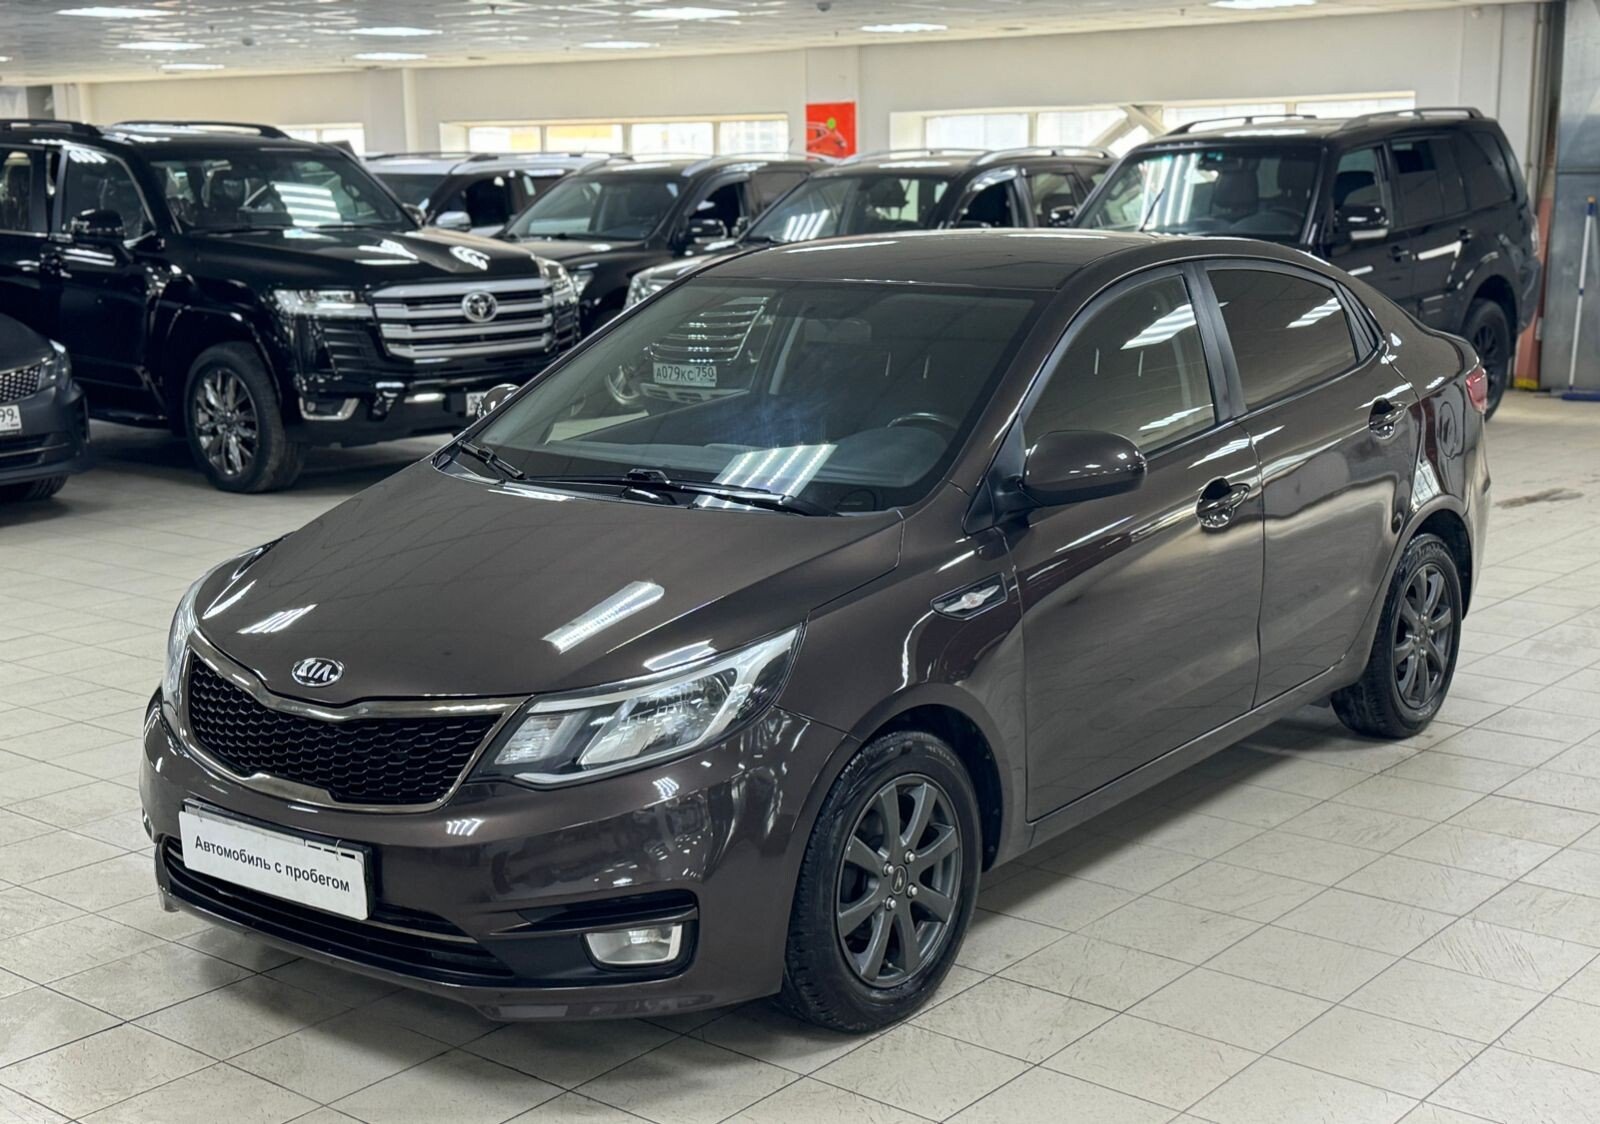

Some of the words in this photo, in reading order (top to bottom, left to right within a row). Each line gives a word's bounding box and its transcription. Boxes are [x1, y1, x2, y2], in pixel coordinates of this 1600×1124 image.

[696, 367, 714, 378] 750
[296, 659, 333, 681] KIA
[195, 835, 271, 871] Автомобиль
[274, 862, 282, 874] с
[285, 865, 351, 893] пробегом
